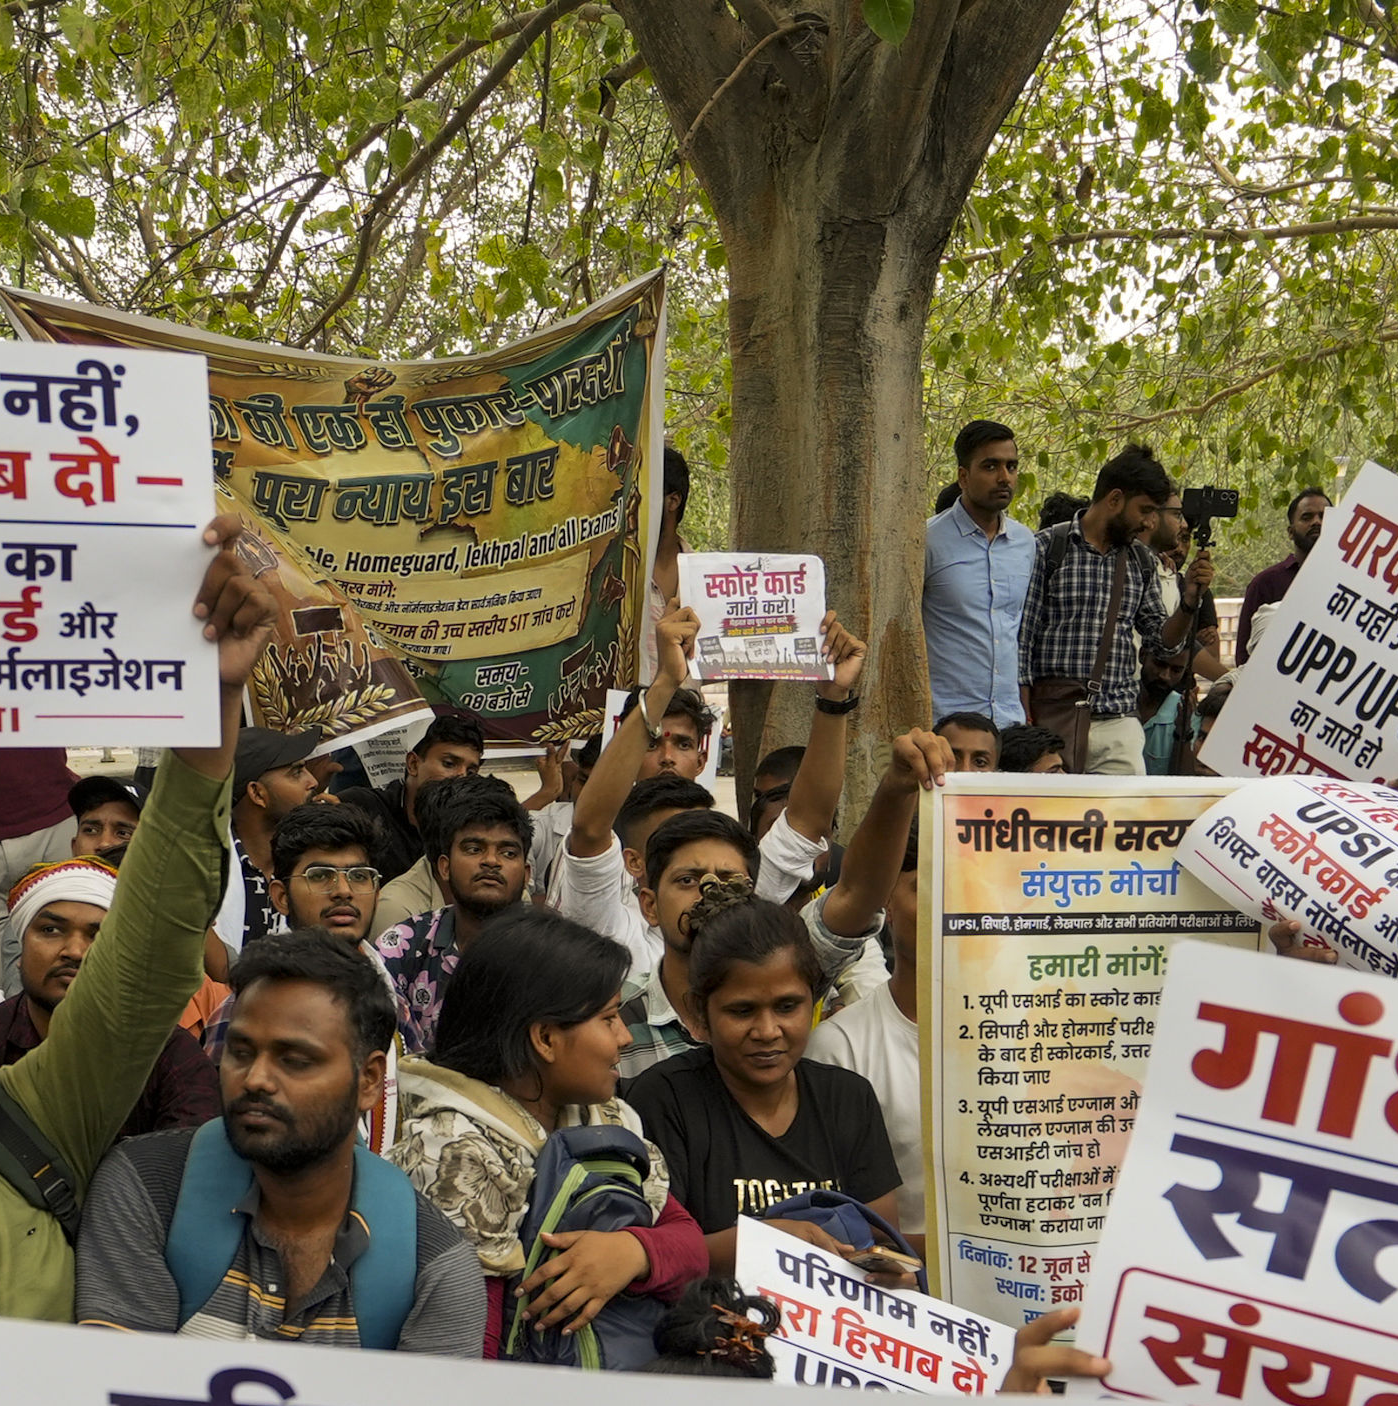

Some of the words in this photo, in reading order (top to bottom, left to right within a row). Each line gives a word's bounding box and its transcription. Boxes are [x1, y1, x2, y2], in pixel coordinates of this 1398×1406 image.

[1, 542, 77, 582] का
[345, 552, 460, 576] Homeguard,
[465, 536, 525, 569] lekhpal
[530, 531, 556, 557] and
[704, 565, 758, 598] स्कोर
[762, 563, 807, 595] कार्ड
[58, 603, 117, 640] और
[509, 613, 529, 632] SIT
[726, 596, 757, 616] जारी
[1326, 583, 1361, 623] का
[1290, 700, 1320, 733] का
[1316, 715, 1363, 757] जारी
[1355, 736, 1384, 770] हो
[956, 808, 1107, 853] गांधीवादी
[1294, 801, 1397, 870] UPSI
[1021, 862, 1103, 908] संयुक्त
[1109, 861, 1180, 896] मोर्चा
[1257, 813, 1389, 921] स्कोरकार्ड
[949, 919, 980, 931] UPSI,
[1054, 916, 1093, 930] लेखपाल
[1095, 914, 1113, 929] और
[1115, 916, 1136, 929] सभी
[1138, 915, 1177, 930] प्रतियोगी
[1179, 913, 1221, 929] परीक्षाओं
[1223, 914, 1234, 928] के
[1028, 945, 1100, 980] हमारी
[979, 990, 1008, 1015] यूपी
[1013, 989, 1063, 1009] एसआई
[1066, 994, 1085, 1007] का
[1090, 988, 1129, 1007] स्कोर
[958, 1240, 1012, 1270] दिनांक:
[1018, 1255, 1036, 1274] 12
[1042, 1257, 1073, 1281] जून
[1077, 1251, 1091, 1273] से
[776, 1249, 916, 1328] परिणाम
[928, 1309, 999, 1367] नहीं,
[832, 1307, 943, 1383] हिसाब
